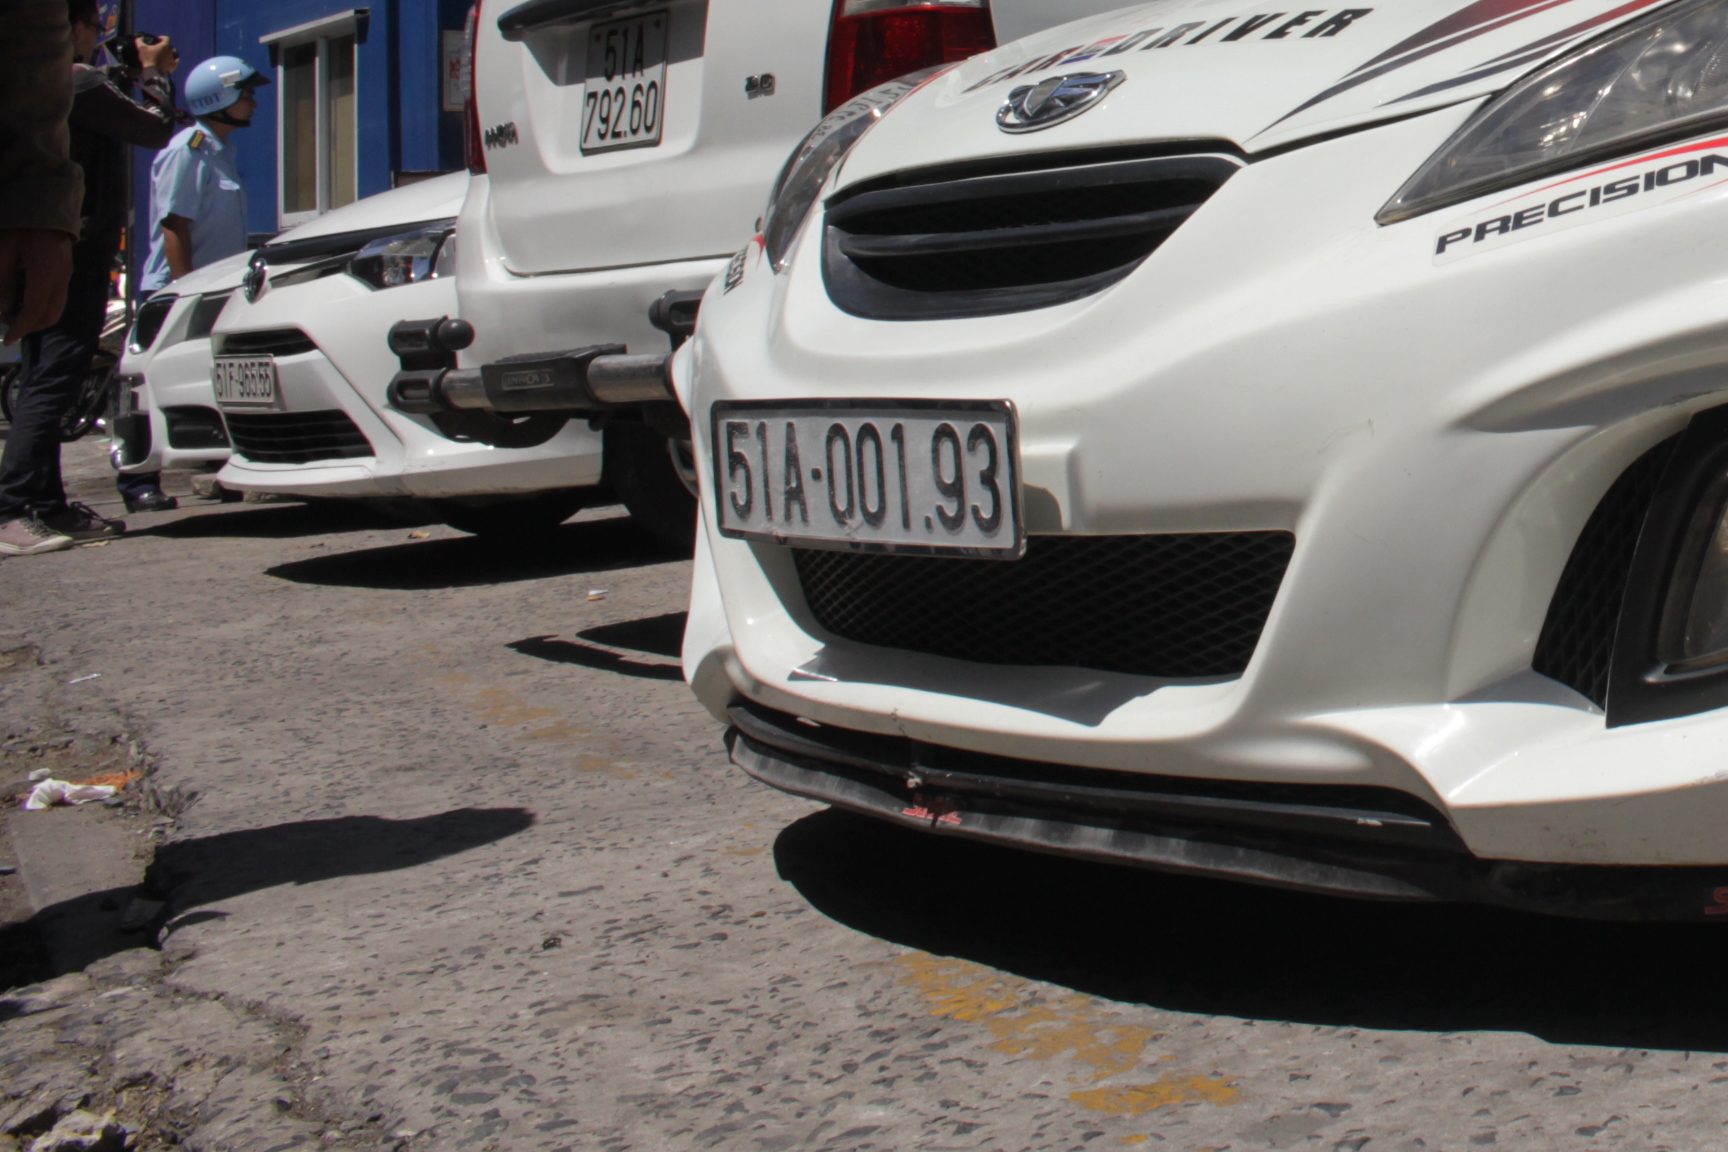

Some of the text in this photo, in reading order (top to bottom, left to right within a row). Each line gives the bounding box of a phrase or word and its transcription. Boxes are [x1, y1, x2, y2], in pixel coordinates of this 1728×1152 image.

[603, 23, 645, 82] 51A
[1097, 6, 1374, 59] DRIVER
[583, 79, 659, 144] 792.60
[725, 420, 1003, 536] 51A-001.93
